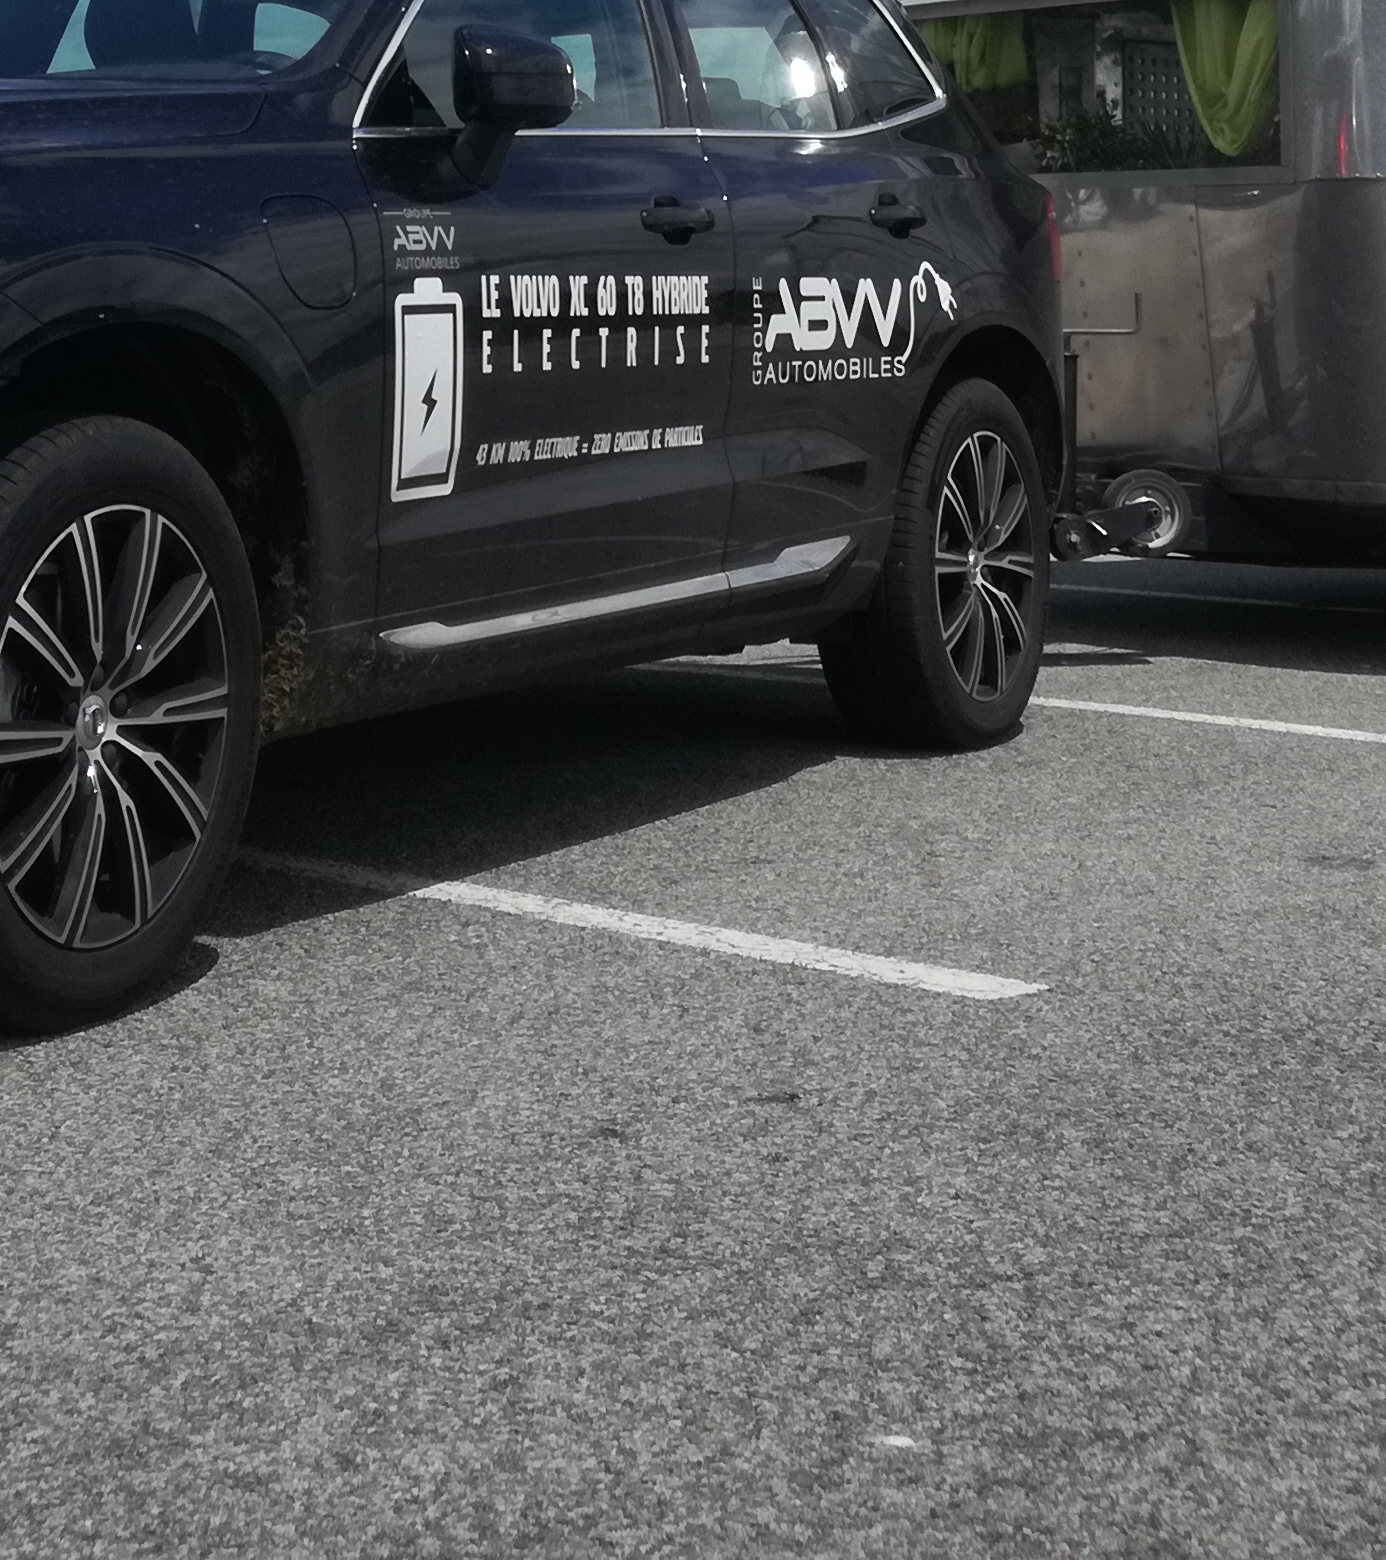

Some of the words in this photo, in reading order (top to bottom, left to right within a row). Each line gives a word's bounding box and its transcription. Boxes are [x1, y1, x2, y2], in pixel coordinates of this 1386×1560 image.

[395, 256, 460, 271] AUTOMOBILES
[481, 274, 501, 317] LE
[509, 274, 560, 317] VOLVO
[569, 275, 589, 317] XC
[597, 275, 617, 316] 60
[624, 275, 644, 316] T8
[652, 275, 710, 315] HYBRIDE
[482, 324, 710, 373] ELECTRISE
[752, 276, 763, 385] GROUPE
[763, 356, 906, 385] AUTOMOBILES
